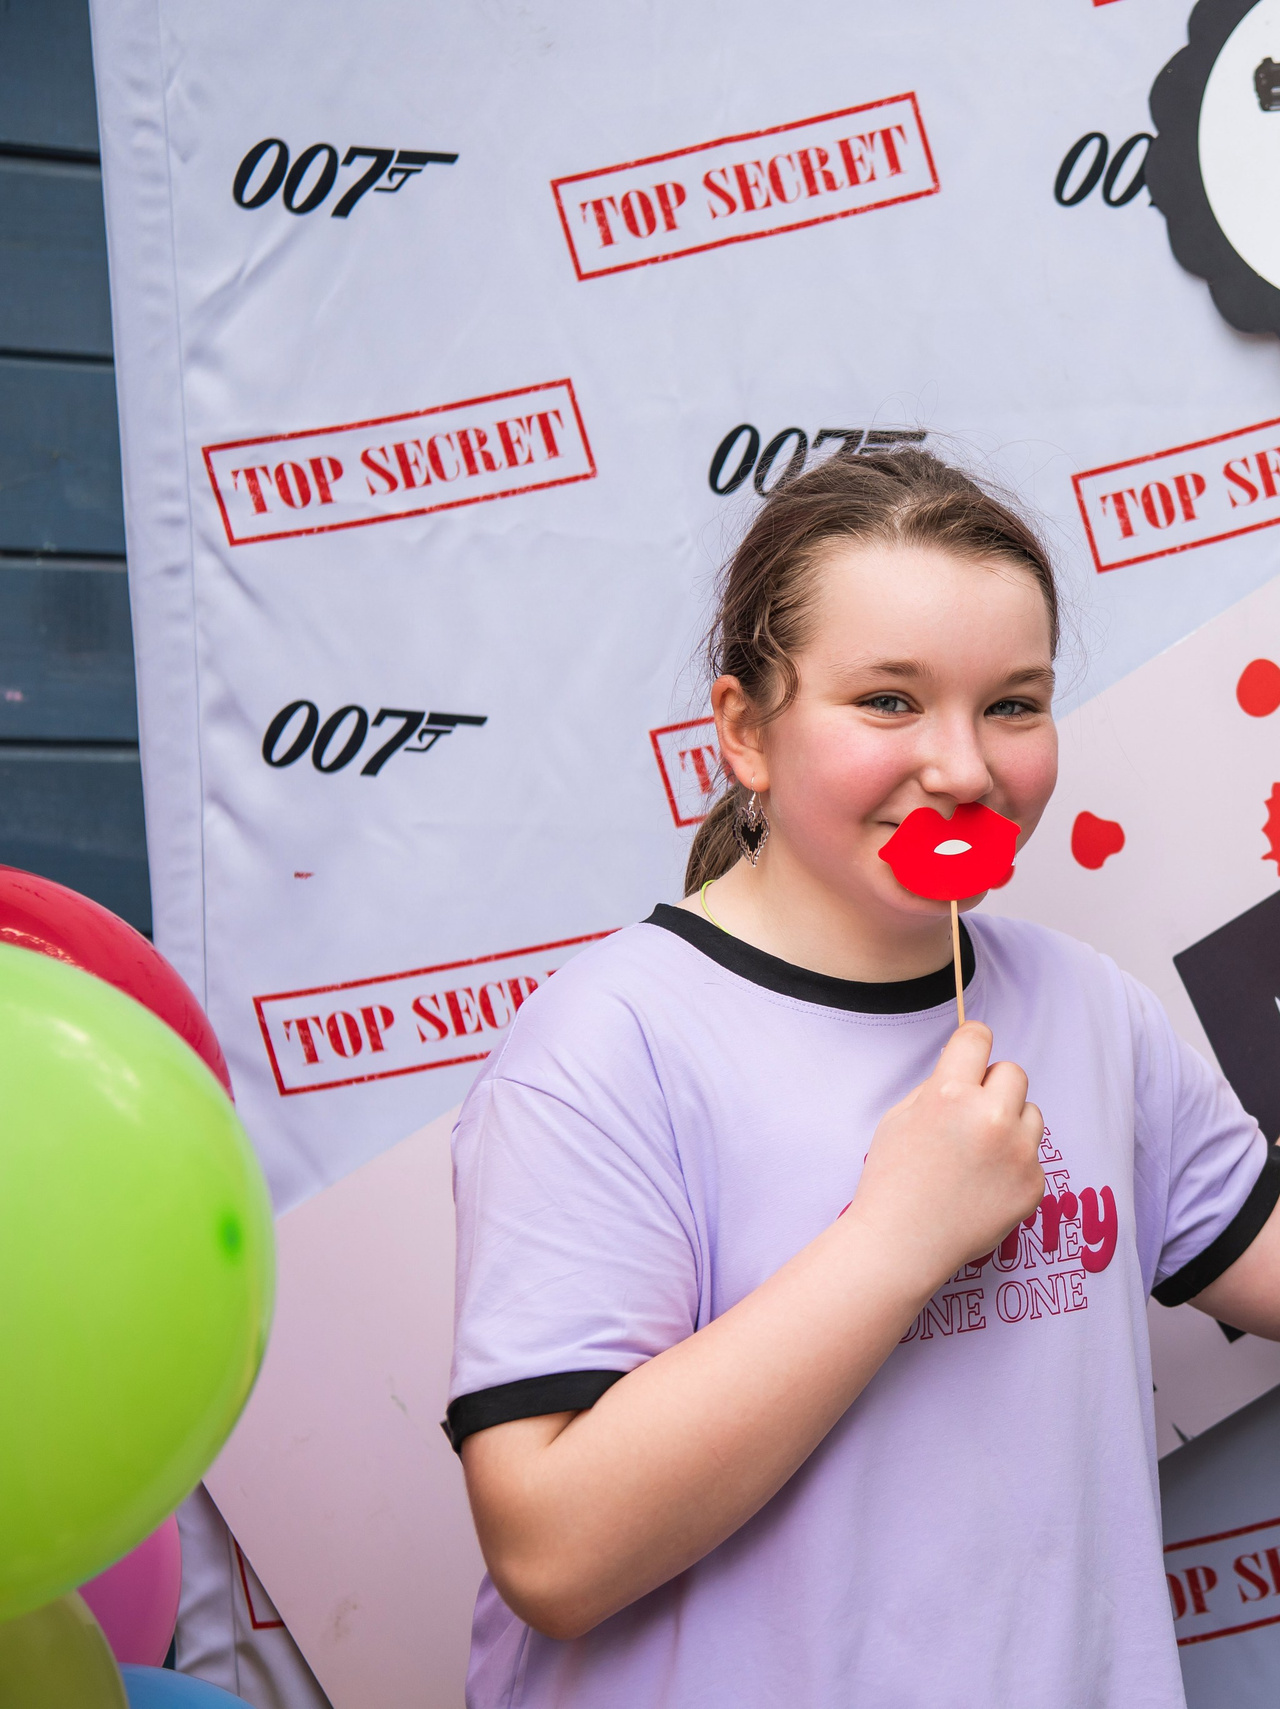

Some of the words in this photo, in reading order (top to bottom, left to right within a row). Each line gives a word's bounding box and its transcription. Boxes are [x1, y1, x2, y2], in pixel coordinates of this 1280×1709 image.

[231, 138, 397, 218] 007
[579, 181, 687, 249] TOP
[702, 123, 908, 220] SECRET
[1053, 131, 1155, 208] 00
[230, 455, 345, 517] TOP
[359, 408, 565, 497] SECRET
[1099, 472, 1207, 541] TOP
[262, 700, 428, 777] 007
[282, 1004, 396, 1067] TOP
[996, 1268, 1088, 1324] ONE
